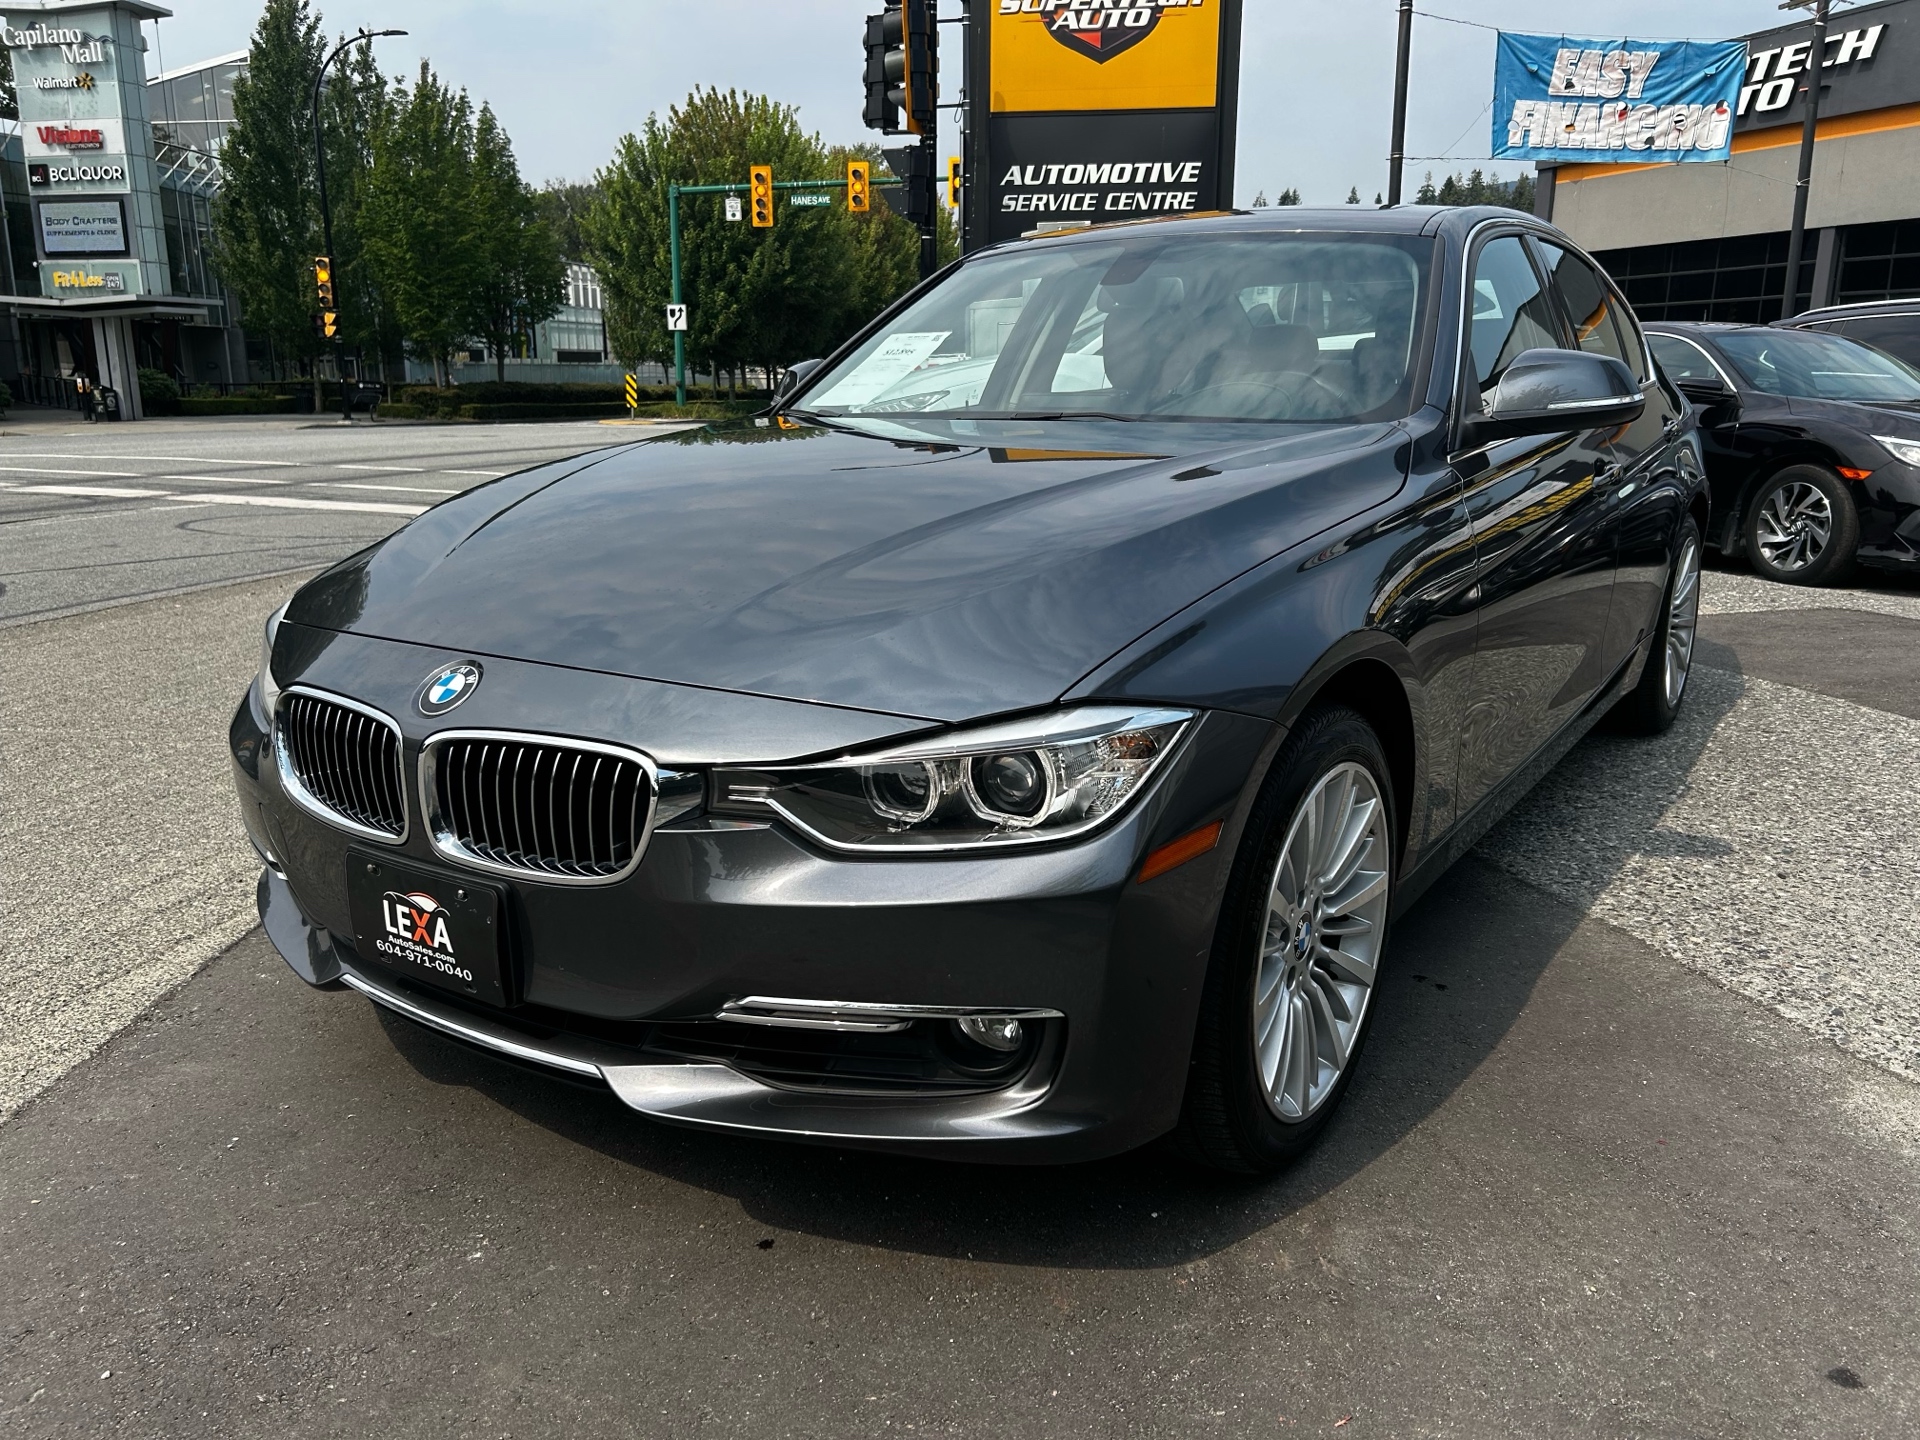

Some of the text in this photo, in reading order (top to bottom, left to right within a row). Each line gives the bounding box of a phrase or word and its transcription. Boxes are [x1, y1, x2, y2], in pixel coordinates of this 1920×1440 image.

[1050, 8, 1152, 31] AUTO
[2, 23, 82, 50] Capilano
[59, 42, 104, 65] Mall
[33, 77, 78, 90] Walmart
[1548, 48, 1661, 98] EASY
[37, 126, 101, 144] Visions
[1508, 100, 1731, 151] FINANCING
[1000, 162, 1202, 187] AUTOMOTIVE
[791, 196, 818, 206] HANES
[1001, 190, 1199, 213] SERVICE CENTRE
[441, 666, 477, 684] BMW
[383, 899, 454, 953] LEXA
[376, 939, 473, 982] 604-971-0040
[388, 934, 456, 965] AutoSales.com
